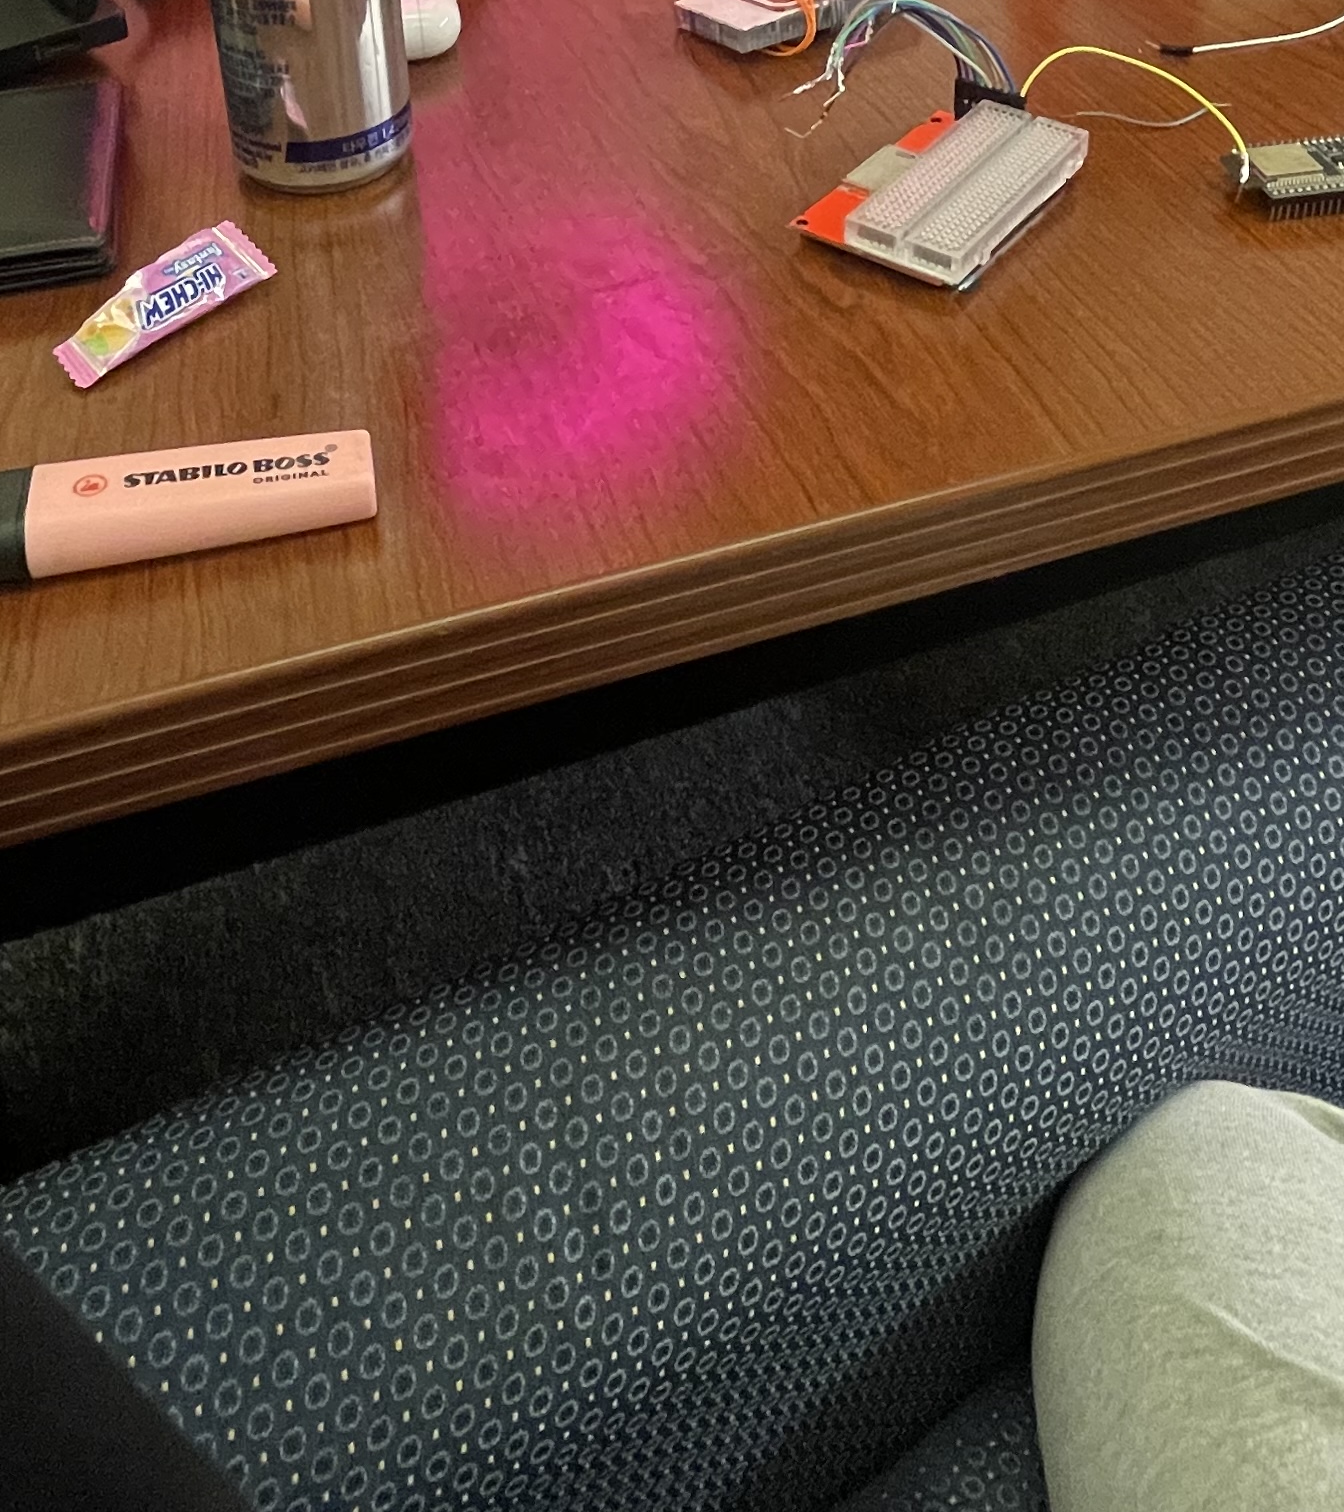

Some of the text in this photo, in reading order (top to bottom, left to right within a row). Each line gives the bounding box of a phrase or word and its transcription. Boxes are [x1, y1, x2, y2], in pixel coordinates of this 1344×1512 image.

[123, 450, 332, 489] STABILO BOSS
[252, 469, 330, 484] ORIGINAL
